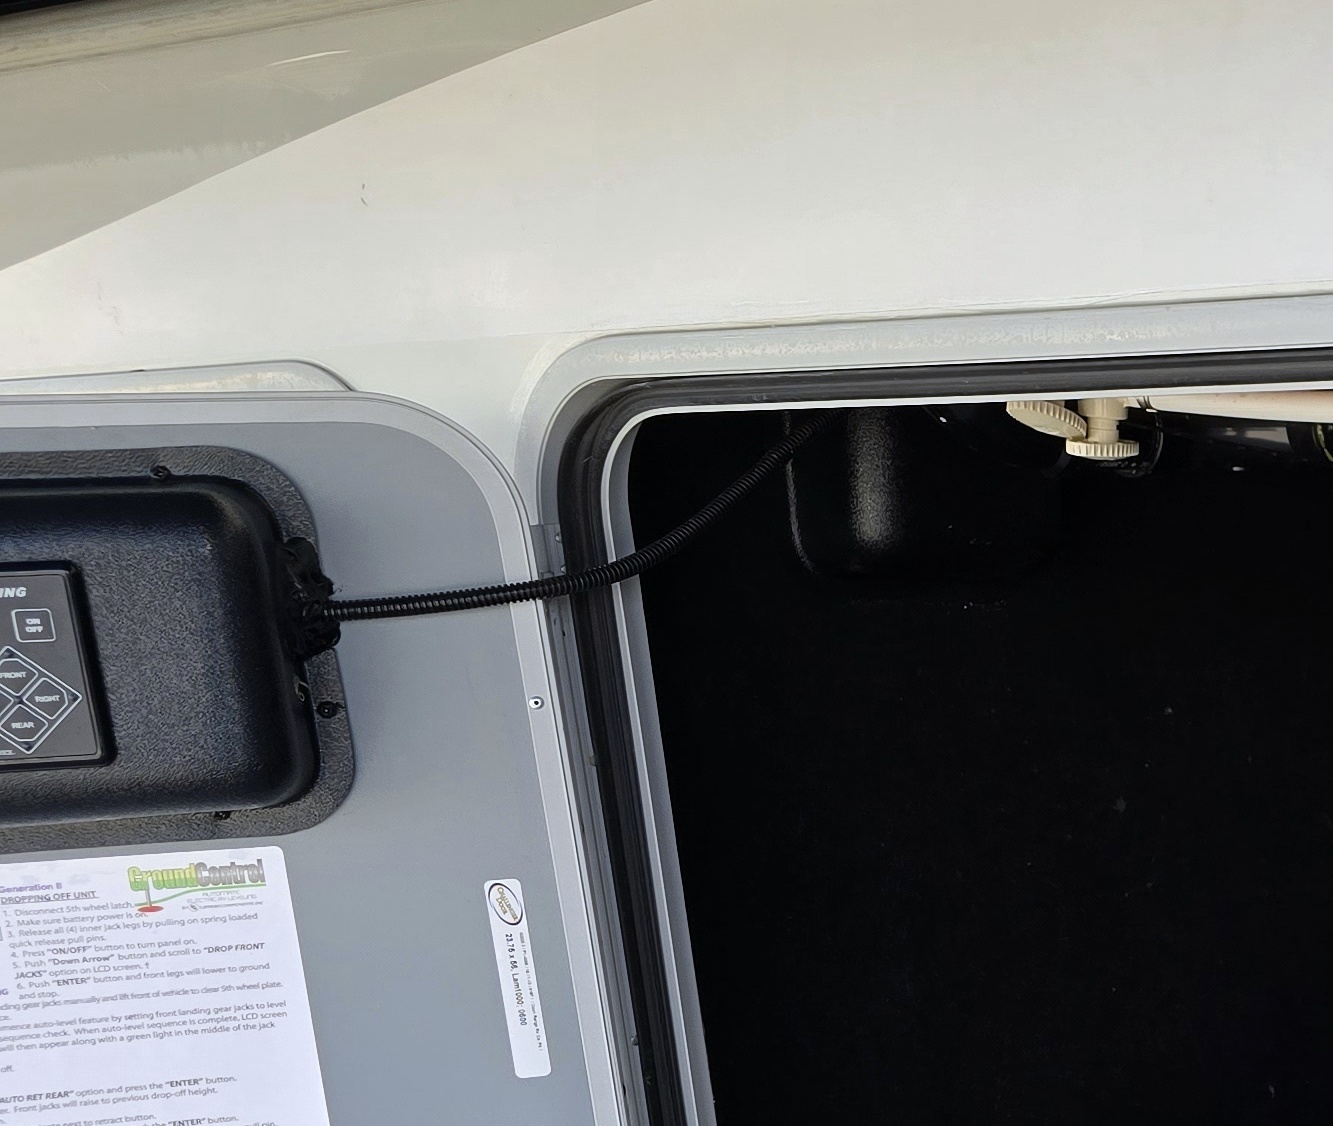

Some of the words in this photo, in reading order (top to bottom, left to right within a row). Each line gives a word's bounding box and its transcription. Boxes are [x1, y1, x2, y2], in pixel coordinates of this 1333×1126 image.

[34, 694, 60, 702] RIGHT
[127, 858, 266, 892] GroundControl
[150, 950, 166, 958] and
[235, 942, 265, 951] FRONT
[126, 972, 142, 980] and
[239, 962, 270, 974] ground
